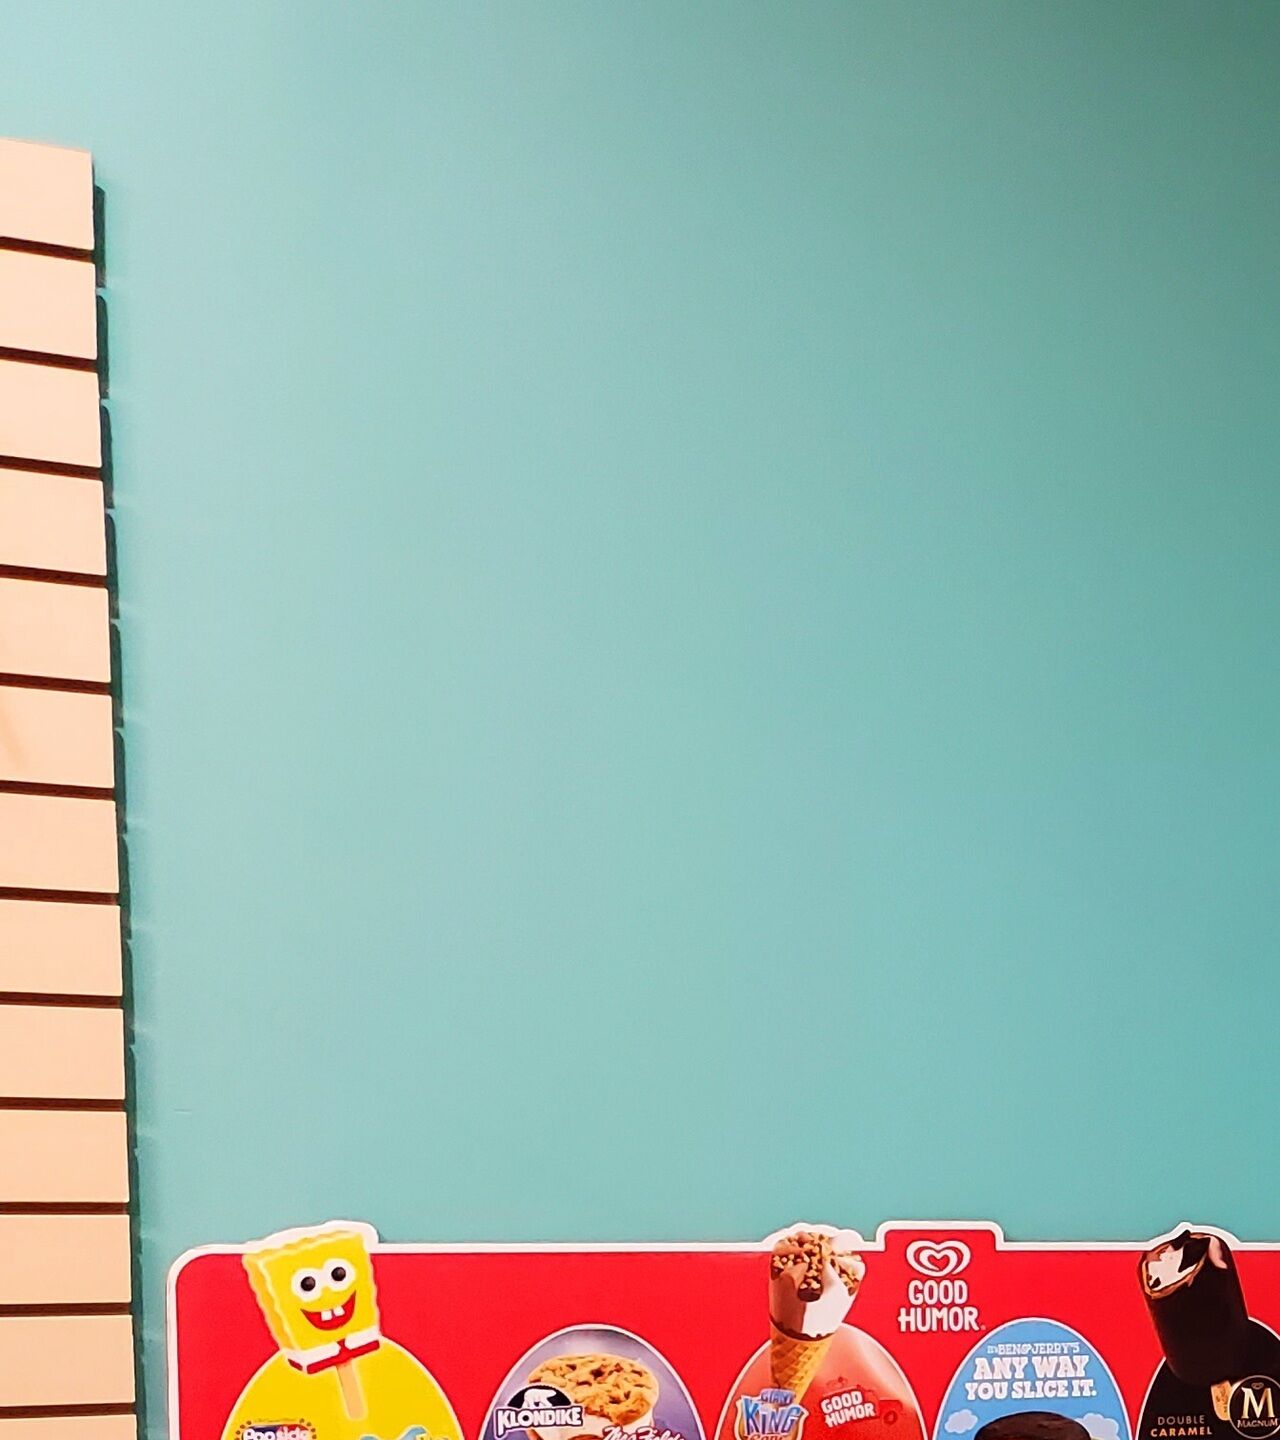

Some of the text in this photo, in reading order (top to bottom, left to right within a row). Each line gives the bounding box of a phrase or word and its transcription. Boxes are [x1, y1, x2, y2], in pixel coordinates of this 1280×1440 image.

[908, 1278, 969, 1306] GOOD
[899, 1306, 980, 1333] HUMOR
[974, 1355, 1089, 1380] ANY WAY
[965, 1379, 1097, 1400] YOU SLICE IT.
[821, 1391, 862, 1413] GOOD
[496, 1408, 583, 1436] KLONDIKE
[825, 1403, 875, 1428] HUMOR
[1158, 1415, 1205, 1425] DOUBLE
[1237, 1418, 1278, 1428] MAGNUM
[1151, 1428, 1212, 1437] CARAMEL
